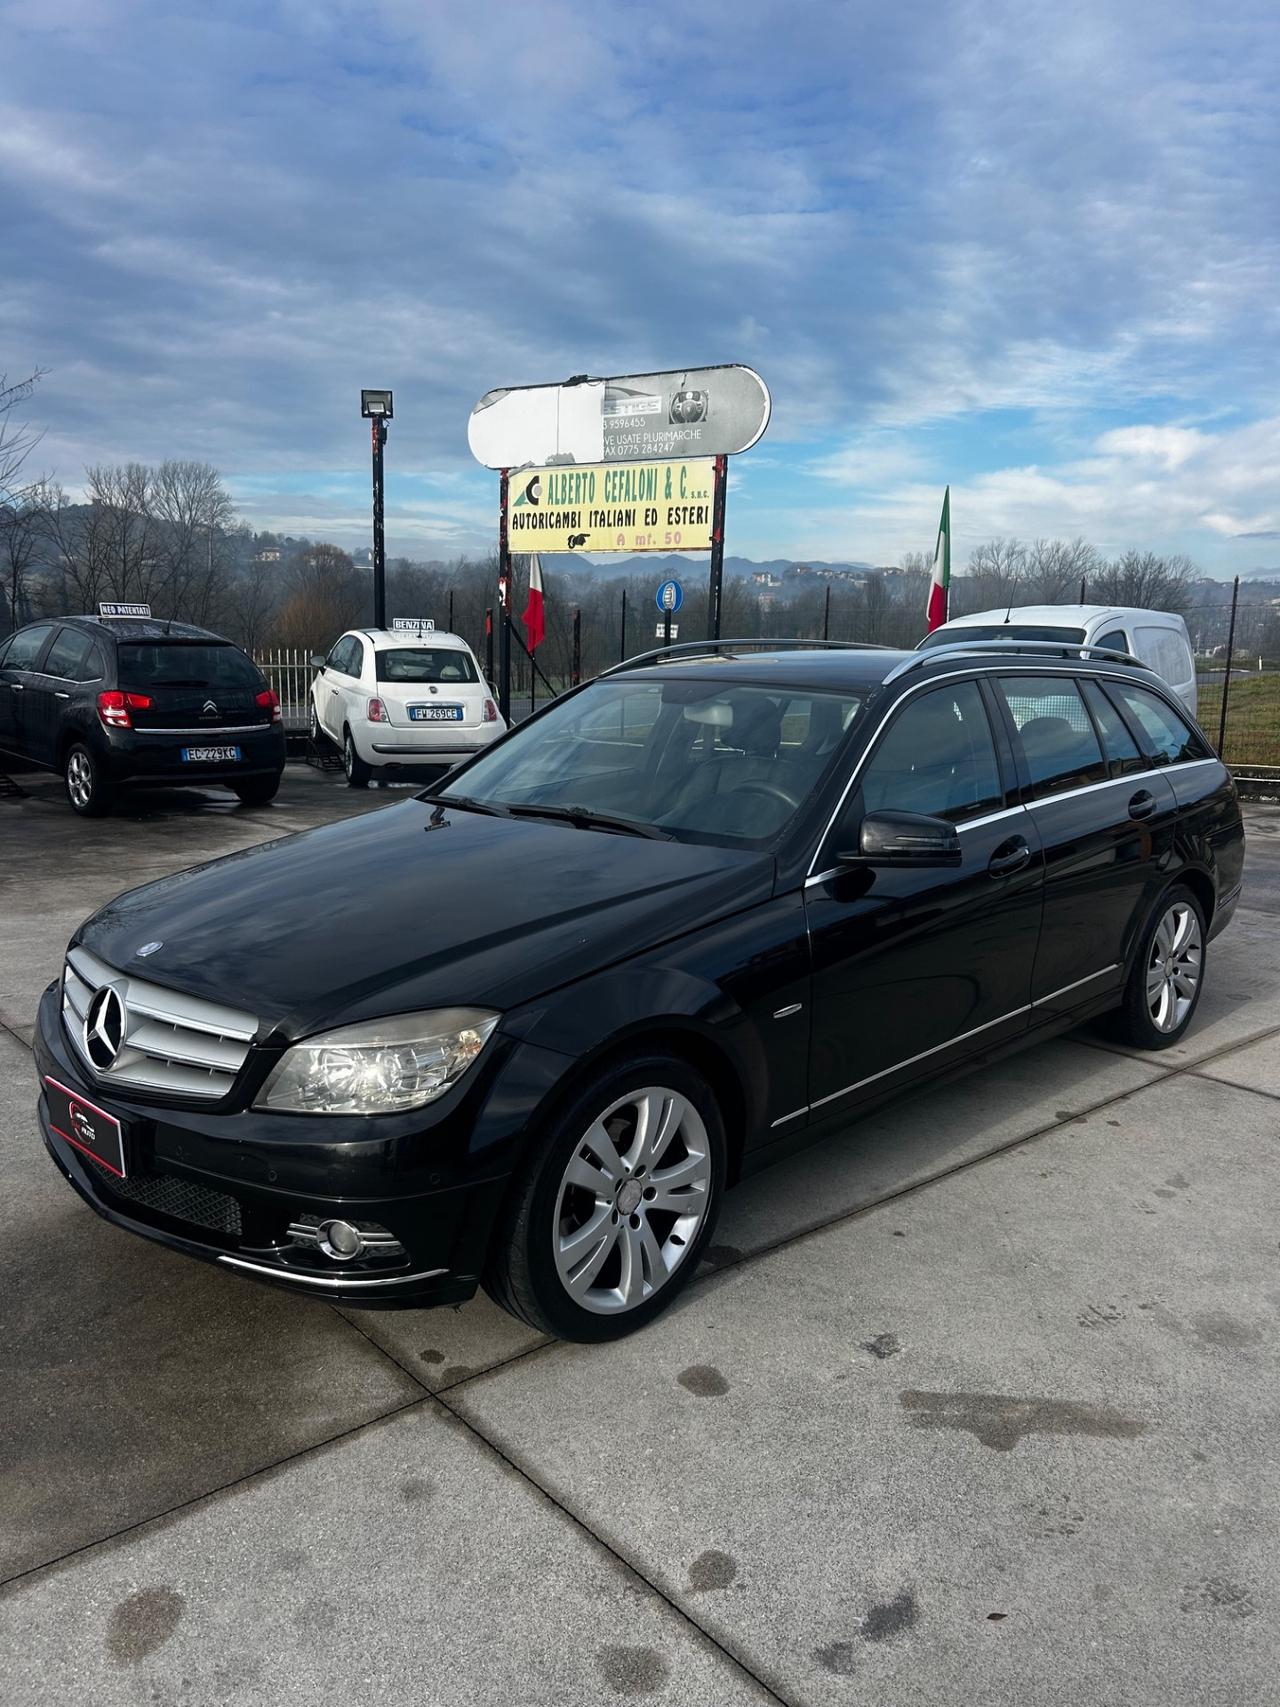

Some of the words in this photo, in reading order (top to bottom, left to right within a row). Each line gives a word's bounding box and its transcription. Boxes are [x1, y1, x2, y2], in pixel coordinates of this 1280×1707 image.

[609, 417, 646, 429] 9596455
[616, 432, 641, 445] USATE
[643, 428, 702, 443] PLURIMARCHE
[617, 444, 639, 455] 0775
[641, 441, 675, 454] 284247
[547, 471, 596, 506] ALBERTO
[604, 467, 658, 503] CEFALONI
[664, 466, 673, 500] &
[680, 465, 689, 500] C.
[512, 510, 581, 530] AUTORICAMBI
[589, 508, 636, 528] ITALIANI
[644, 507, 658, 526] ED
[667, 505, 709, 525] ESTERI
[616, 532, 626, 546] A
[664, 531, 682, 545] 50
[102, 605, 116, 615] NEO
[117, 605, 149, 615] PATENTATI
[395, 620, 433, 630] BENZINA
